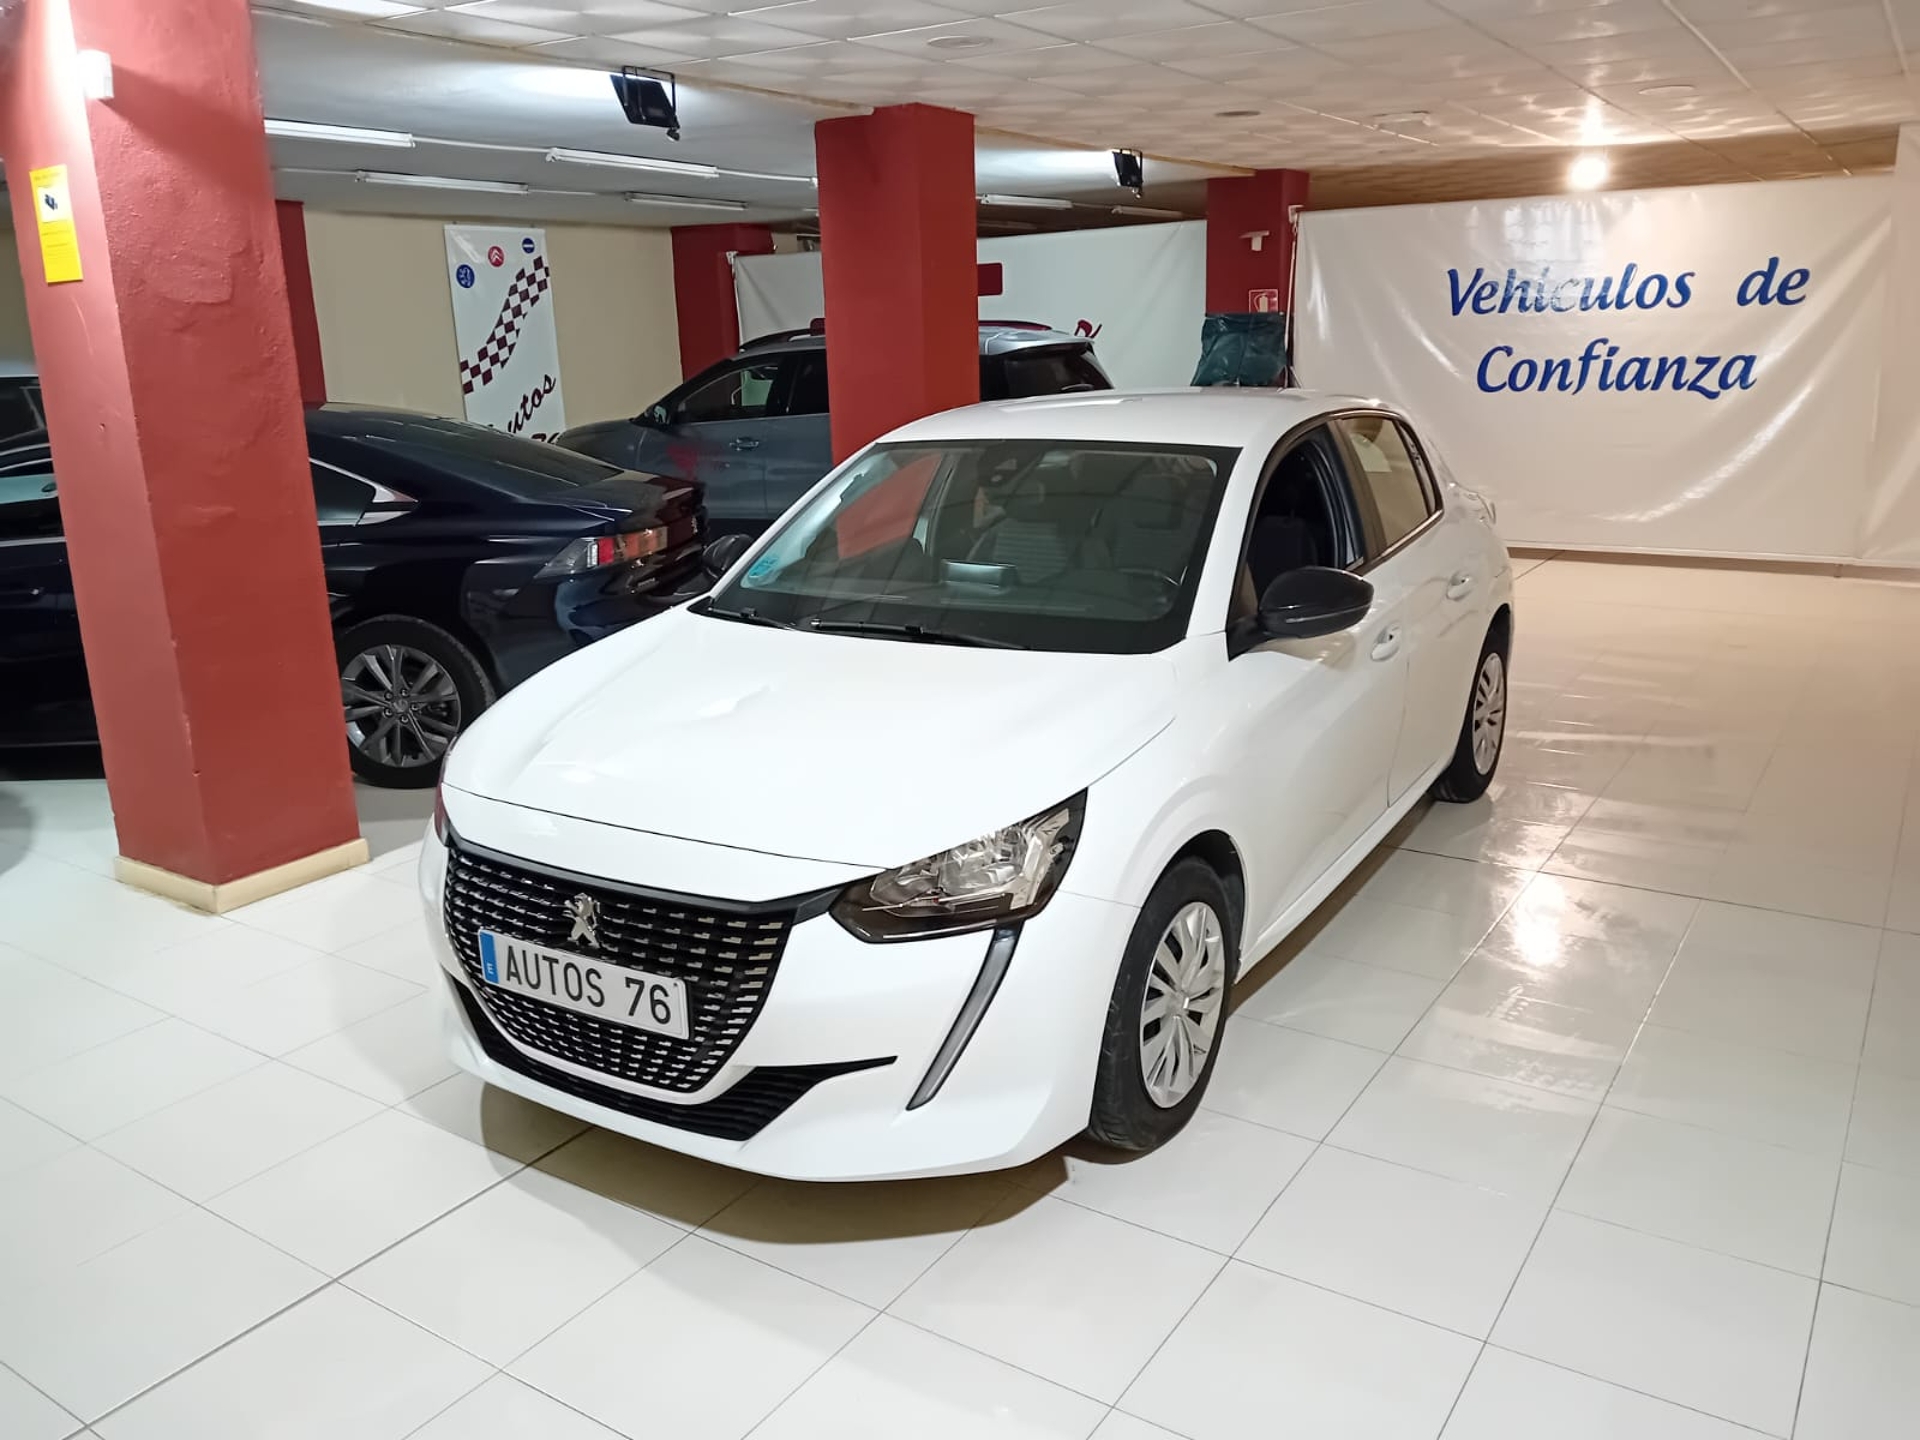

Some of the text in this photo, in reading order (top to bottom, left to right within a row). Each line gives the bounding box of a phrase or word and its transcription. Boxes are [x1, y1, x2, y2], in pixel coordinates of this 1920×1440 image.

[1737, 256, 1810, 307] de
[1476, 337, 1757, 399] Confianza
[487, 373, 557, 434] utos
[506, 945, 671, 1025] AUTOS 76
